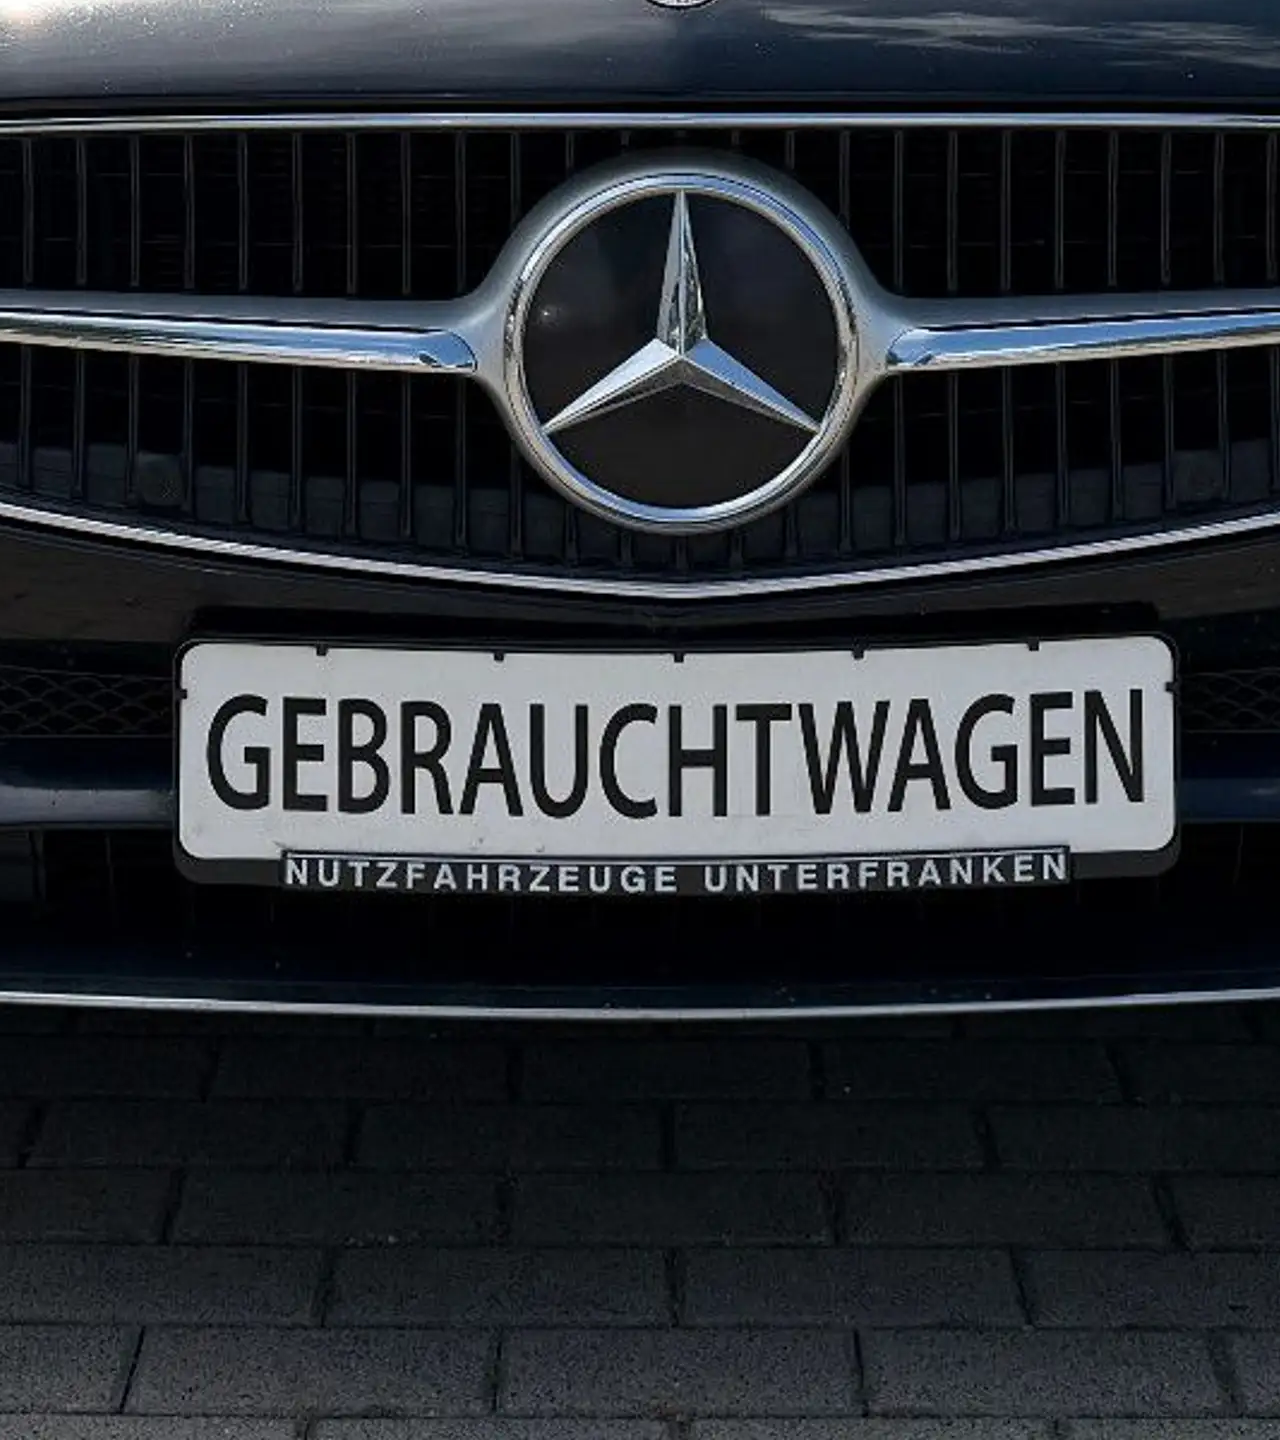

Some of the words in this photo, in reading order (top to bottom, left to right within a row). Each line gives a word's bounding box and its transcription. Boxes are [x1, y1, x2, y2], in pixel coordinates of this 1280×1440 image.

[206, 688, 1144, 820] GEBRAUCHTWAGEN
[285, 858, 677, 893] NUTZFAHRZEUGE
[704, 853, 1066, 892] UNTERFRANKEN
